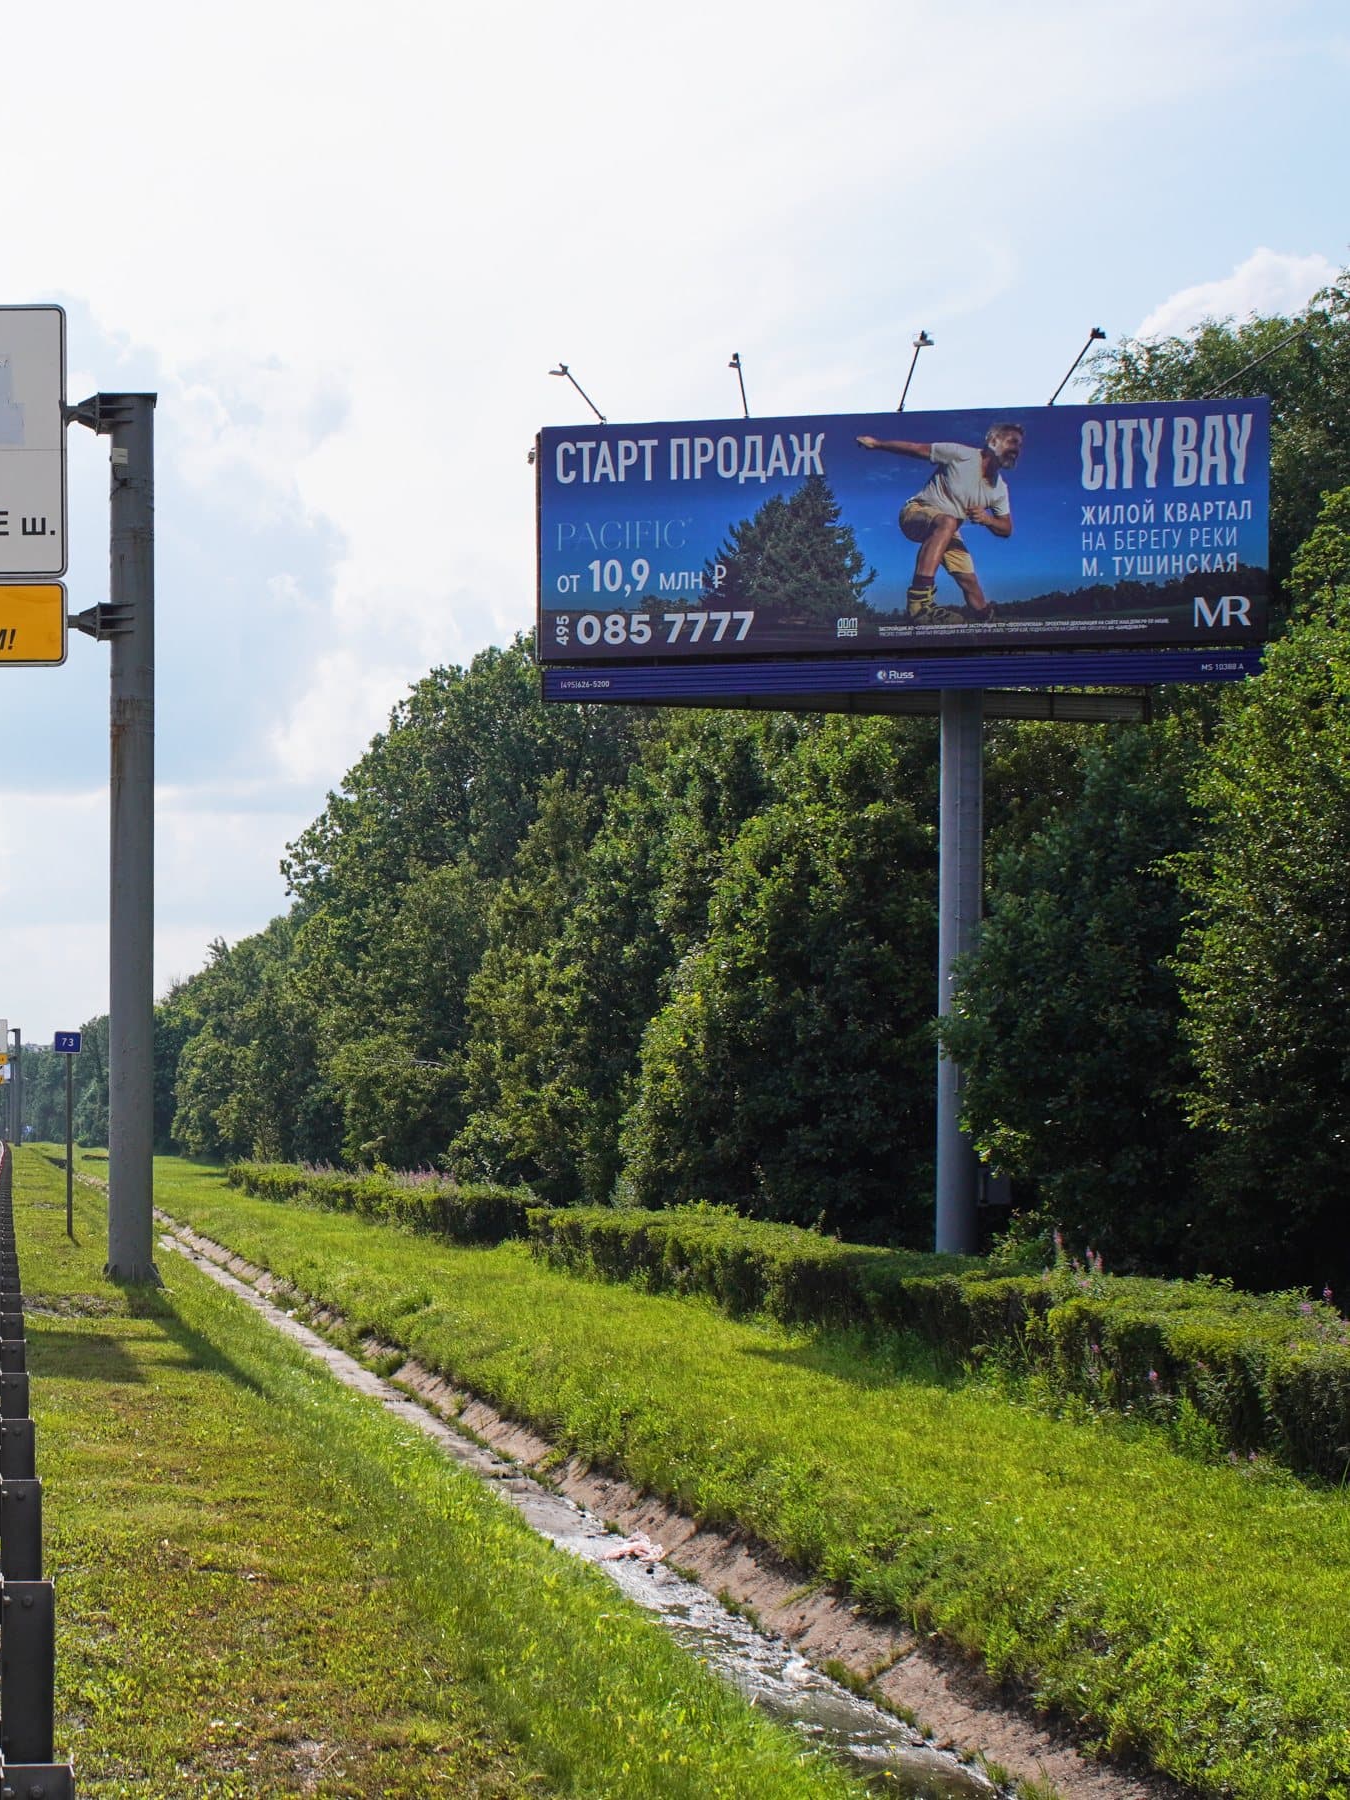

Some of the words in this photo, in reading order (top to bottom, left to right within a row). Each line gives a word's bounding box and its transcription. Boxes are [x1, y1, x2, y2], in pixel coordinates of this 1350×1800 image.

[555, 439, 659, 484] СТАРТ
[670, 432, 825, 484] ПРОДАЖ
[1080, 417, 1164, 491] CITY
[1172, 413, 1253, 488] BAY
[1080, 498, 1155, 526] ЖИЛОЙ
[1163, 500, 1252, 523] КВАРТАЛ
[20, 516, 56, 538] ш.
[1081, 531, 1107, 551] НА
[1114, 528, 1183, 551] БЕРЕГУ
[1189, 526, 1238, 548] РЕКИ
[587, 558, 650, 598] 10,9
[1081, 556, 1105, 577] М.
[1111, 552, 1238, 577] ТУШИНСКАЯ
[1193, 595, 1252, 628] MR
[555, 615, 570, 647] 495
[576, 613, 652, 646] 085
[663, 611, 755, 644] 7777
[888, 670, 915, 680] Russ
[61, 1037, 75, 1047] 73
